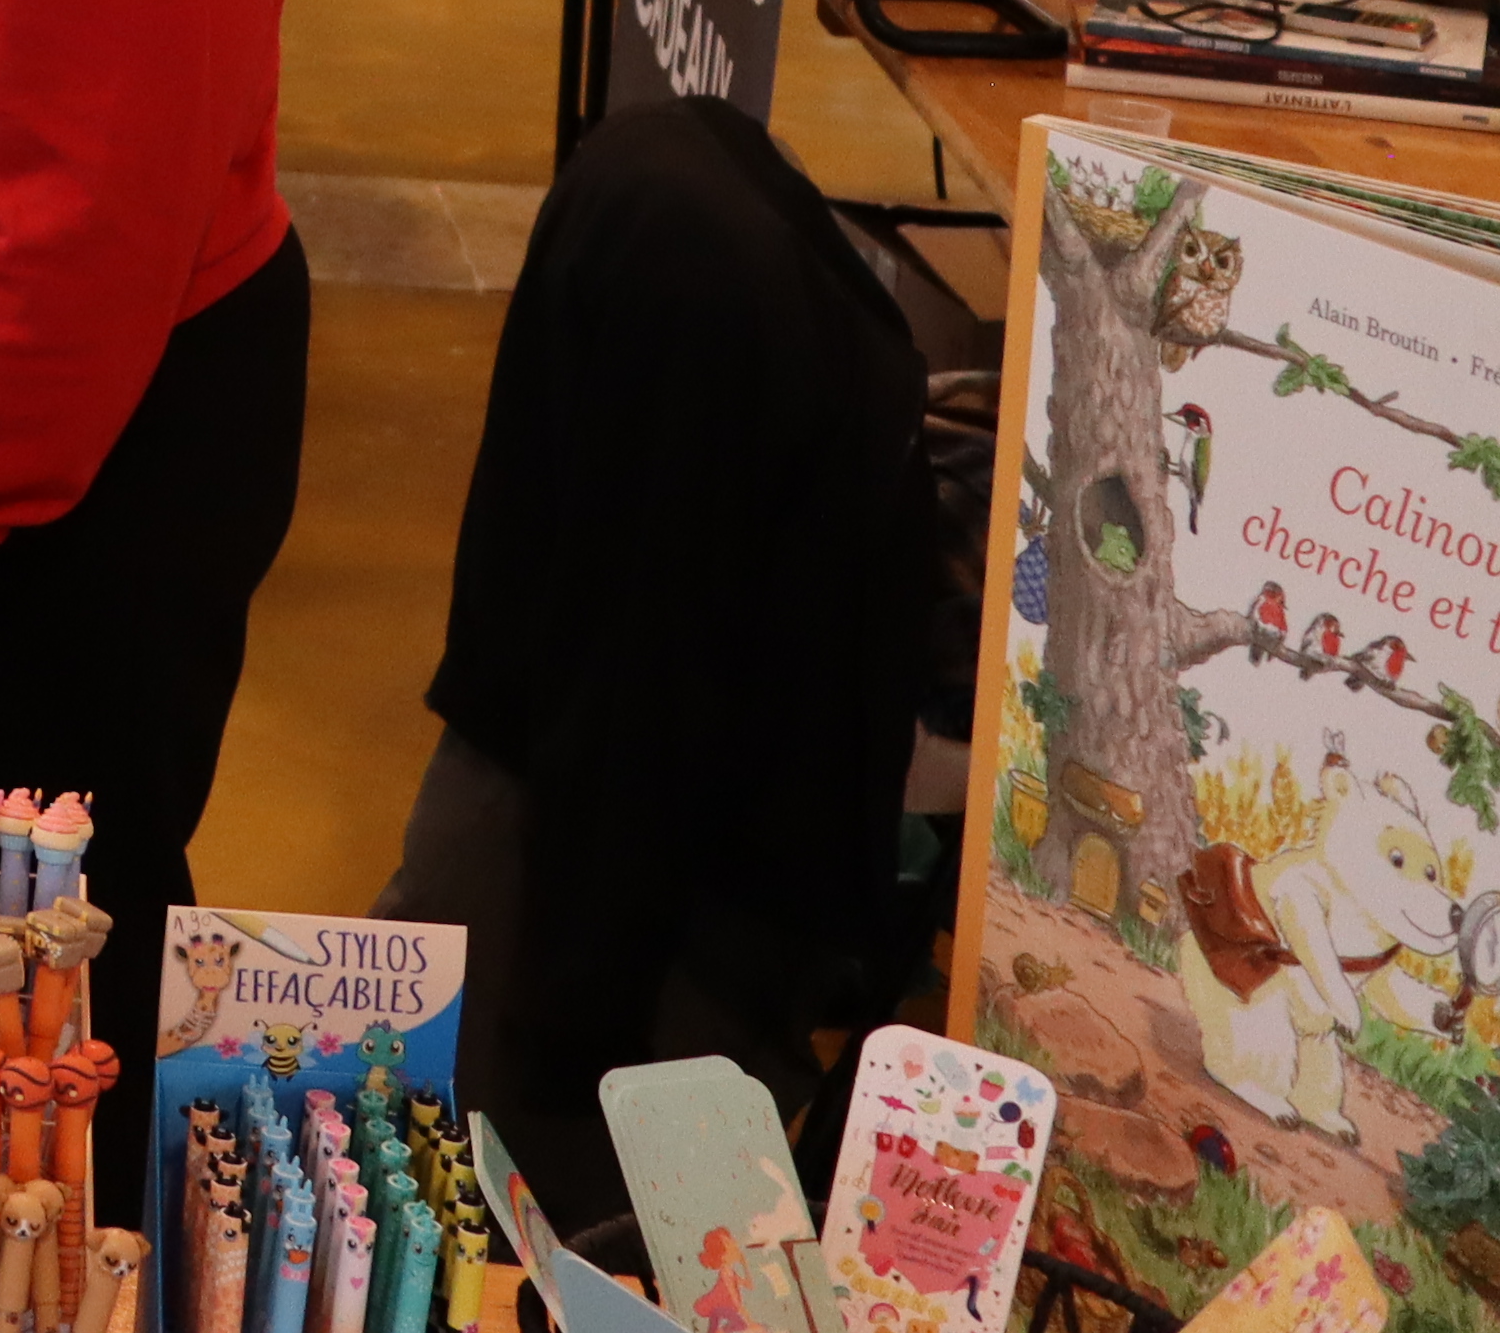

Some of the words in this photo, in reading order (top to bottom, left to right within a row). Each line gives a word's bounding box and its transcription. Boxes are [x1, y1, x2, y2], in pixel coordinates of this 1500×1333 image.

[1263, 92, 1352, 112] L'ATTENTAT
[1308, 297, 1360, 331] Alain
[1365, 315, 1440, 363] Broutin
[1241, 506, 1417, 614] cherche
[1429, 595, 1476, 640] et
[316, 929, 429, 974] STYLOS
[235, 967, 424, 1019] EFFAÇABLES
